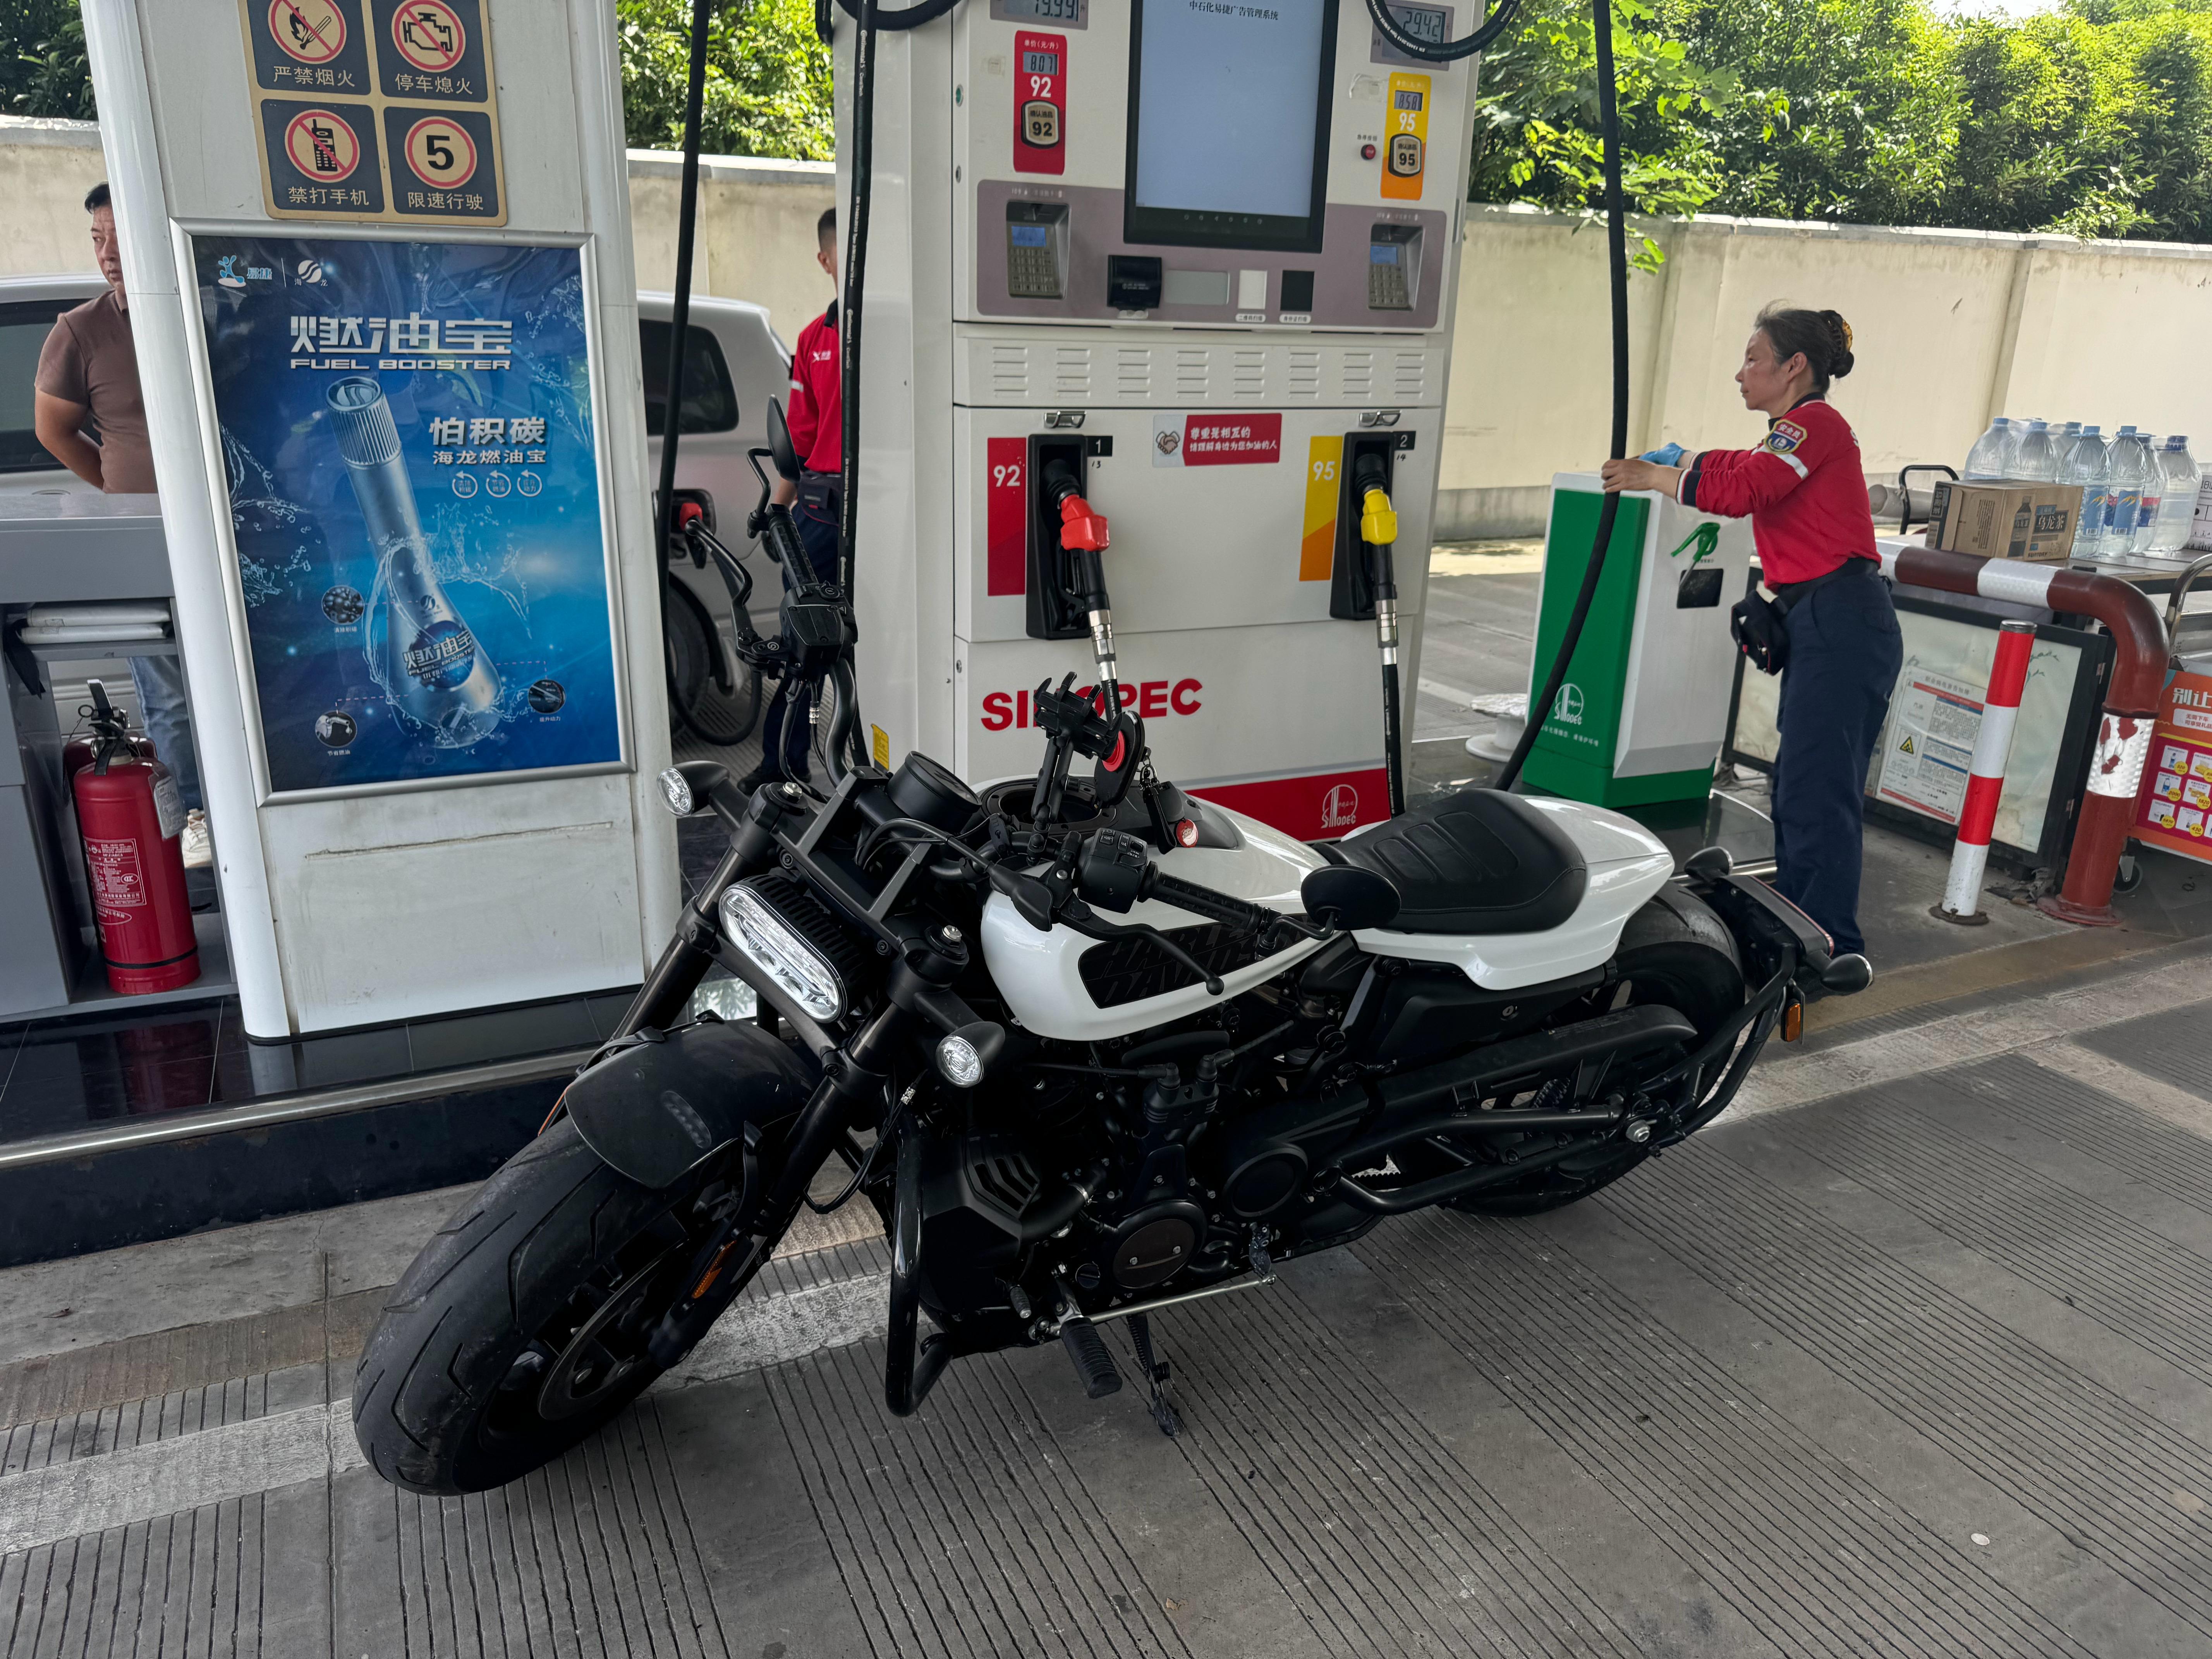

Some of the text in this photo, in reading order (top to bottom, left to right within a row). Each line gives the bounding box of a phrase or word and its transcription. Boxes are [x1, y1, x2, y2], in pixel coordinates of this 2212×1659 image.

[1190, 1, 1278, 20] 中石化易捷广告管理系统
[1403, 11, 1441, 37] 29.42
[273, 66, 355, 88] 严禁烟火
[395, 74, 473, 95] 停车熄火
[1030, 76, 1051, 98] 92
[1032, 122, 1052, 137] 92
[1399, 112, 1416, 132] 95
[426, 135, 454, 170] 5
[1399, 153, 1415, 167] 95
[288, 186, 369, 206] 禁打手机
[408, 192, 484, 210] 限速行驶
[290, 312, 512, 354] 燃油宝
[290, 359, 511, 370] FUEL BOOSTER
[428, 417, 545, 445] 怕积碳
[1095, 440, 1101, 454] 1
[1400, 435, 1407, 448] 2
[433, 449, 546, 465] 海龙燃油宝
[993, 465, 1020, 487] 92
[1313, 461, 1335, 481] 95
[2039, 515, 2065, 530] 乌龙茶
[2172, 687, 2212, 708] 别让
